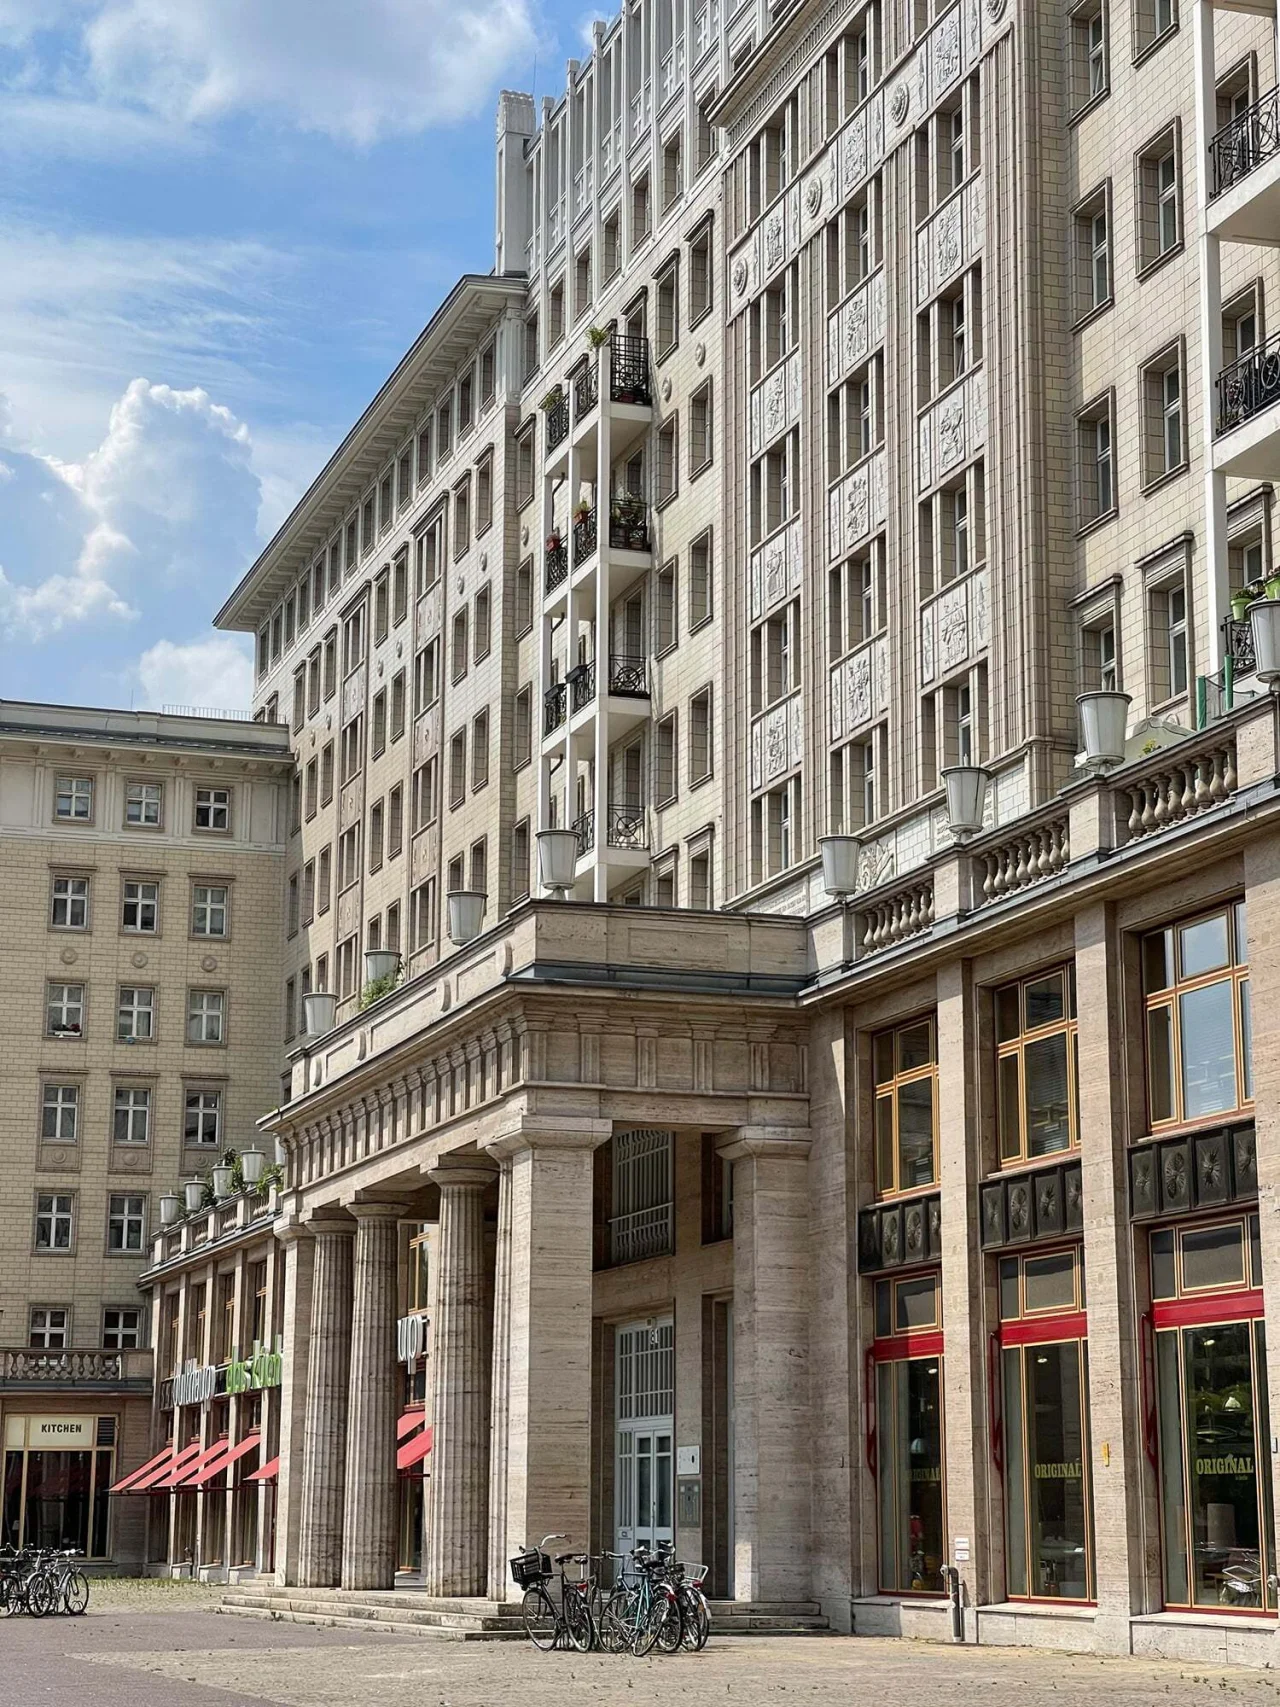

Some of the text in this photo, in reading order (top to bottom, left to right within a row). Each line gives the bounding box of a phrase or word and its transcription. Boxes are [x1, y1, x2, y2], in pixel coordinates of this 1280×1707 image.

[650, 1328, 659, 1344] 81
[41, 1424, 82, 1433] KITCHEN
[1034, 1463, 1083, 1478] ORIGINAL
[1196, 1457, 1254, 1475] ORIGINAL
